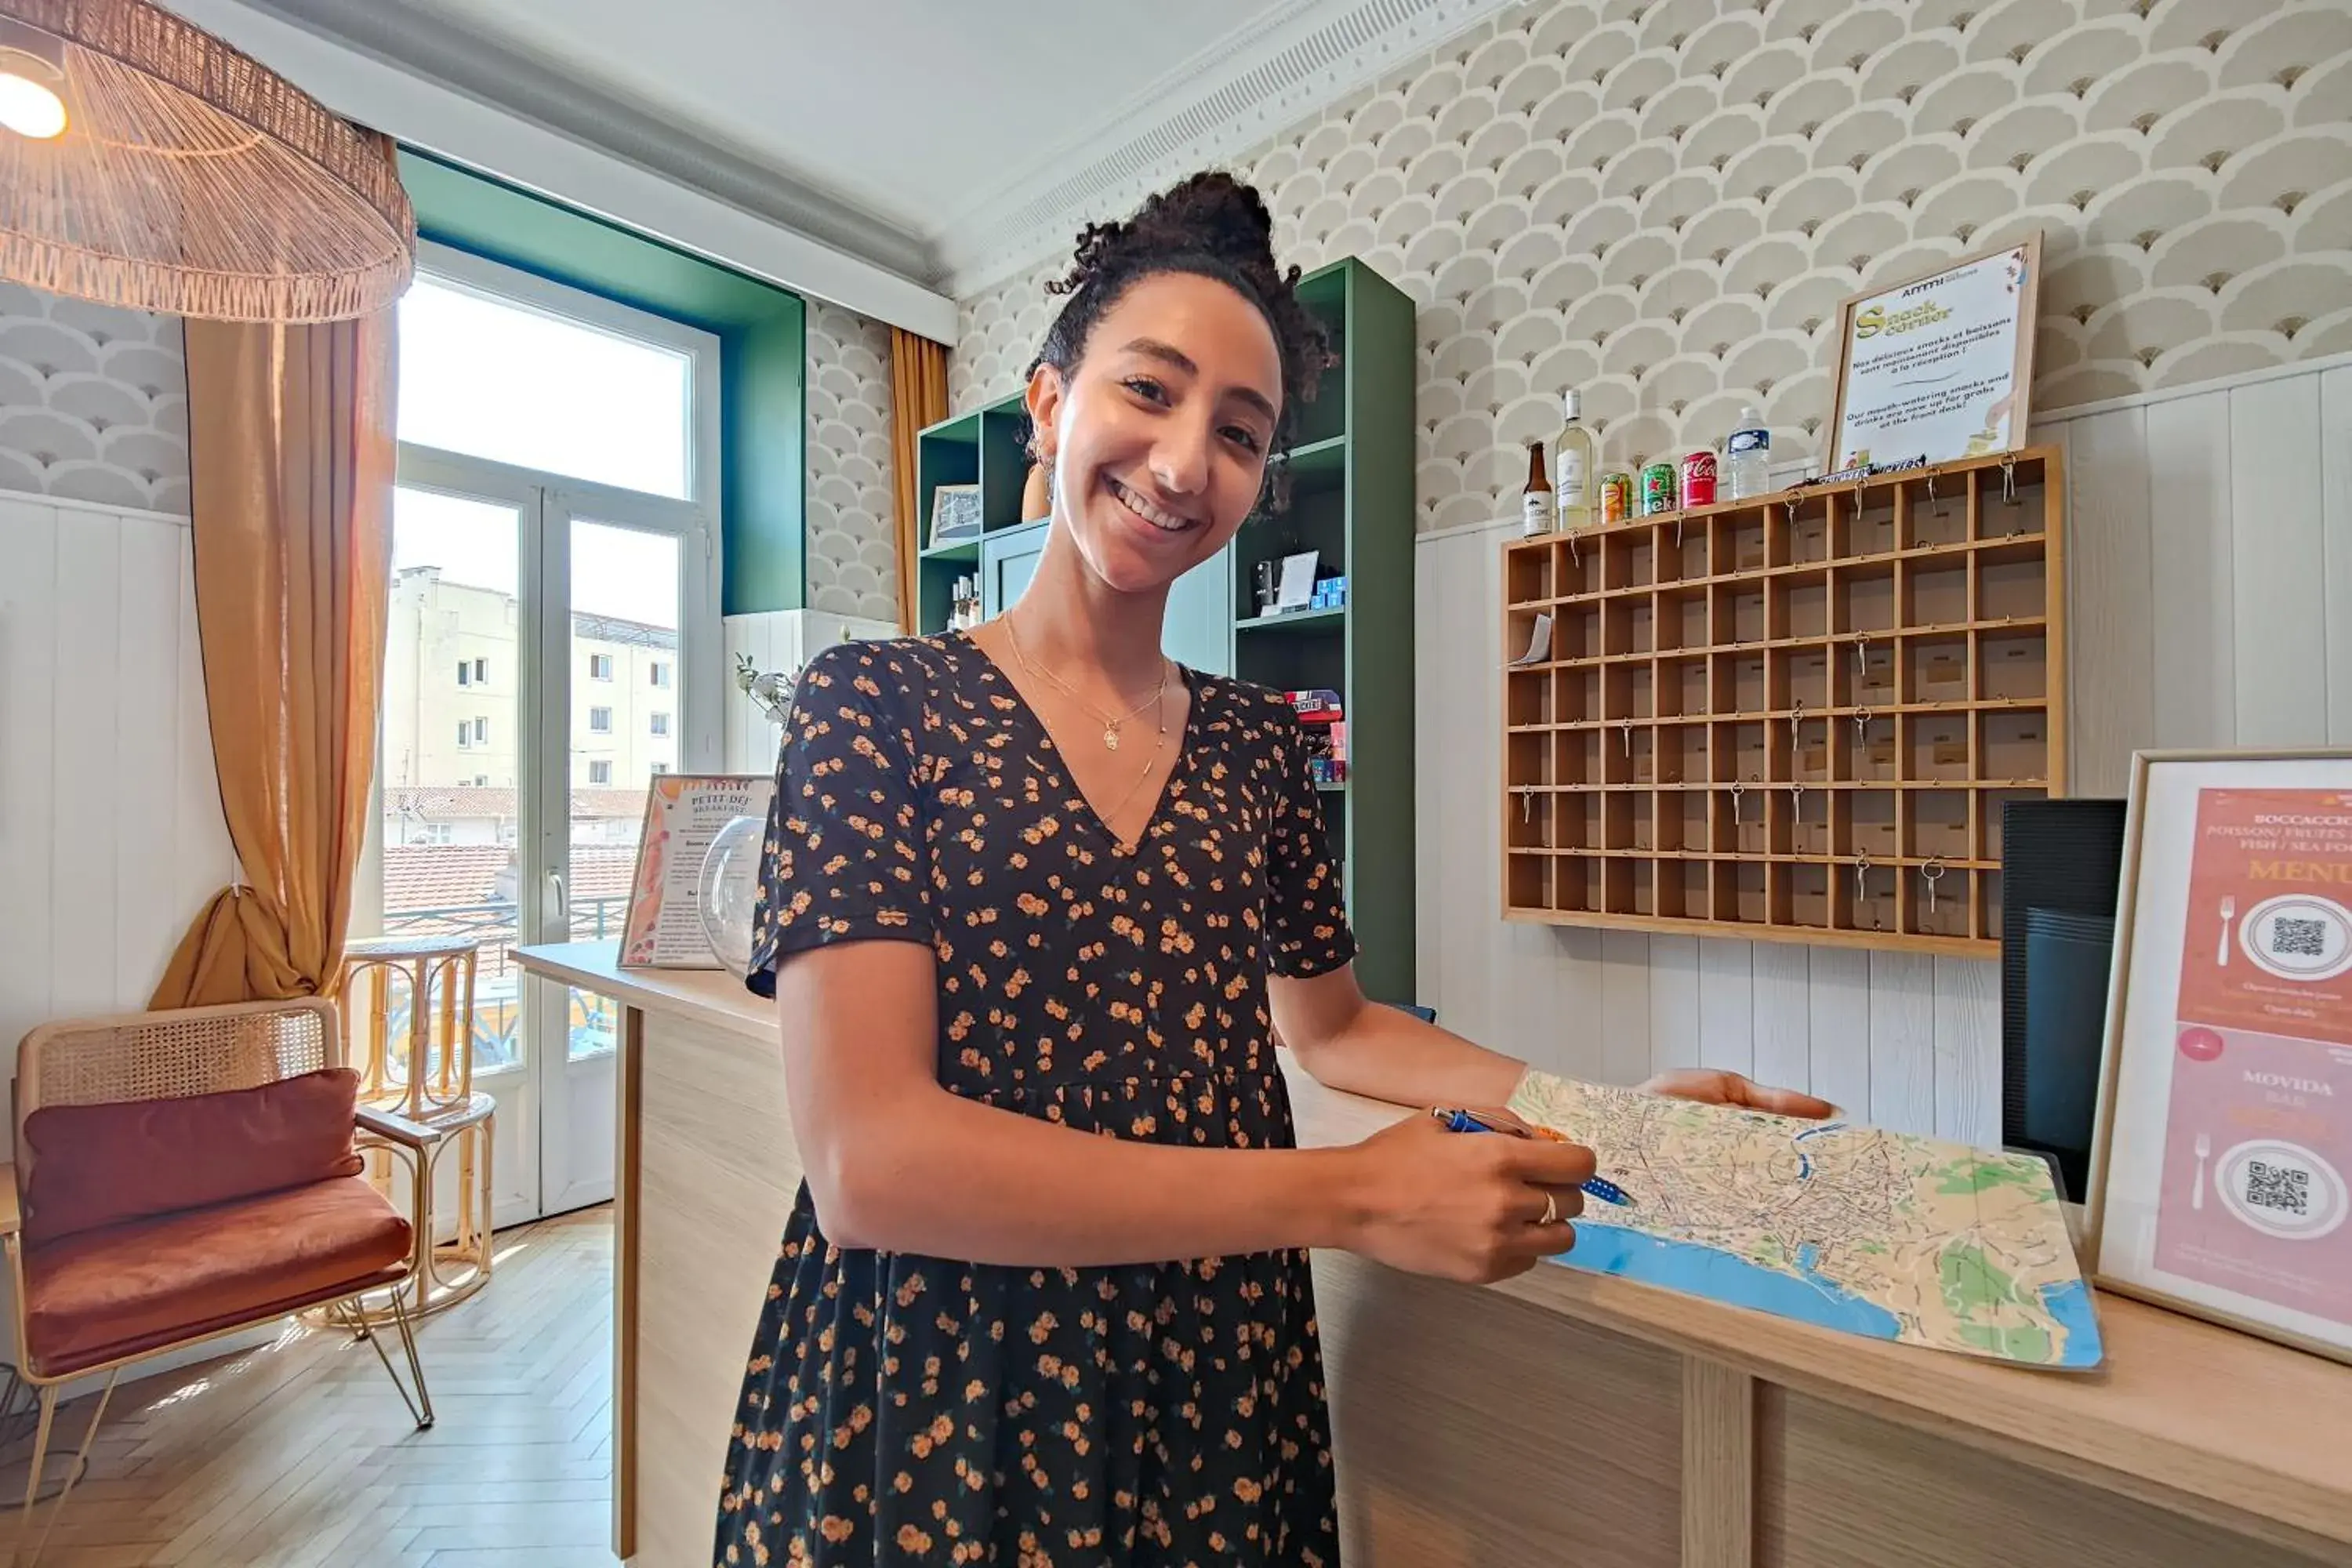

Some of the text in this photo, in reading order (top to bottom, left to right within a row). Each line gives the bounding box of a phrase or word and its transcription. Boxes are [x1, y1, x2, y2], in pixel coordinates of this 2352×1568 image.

[1846, 412, 1865, 422] Our
[1987, 372, 2009, 384] and
[1892, 416, 1907, 426] the
[2243, 1069, 2334, 1096] MOVIDA
